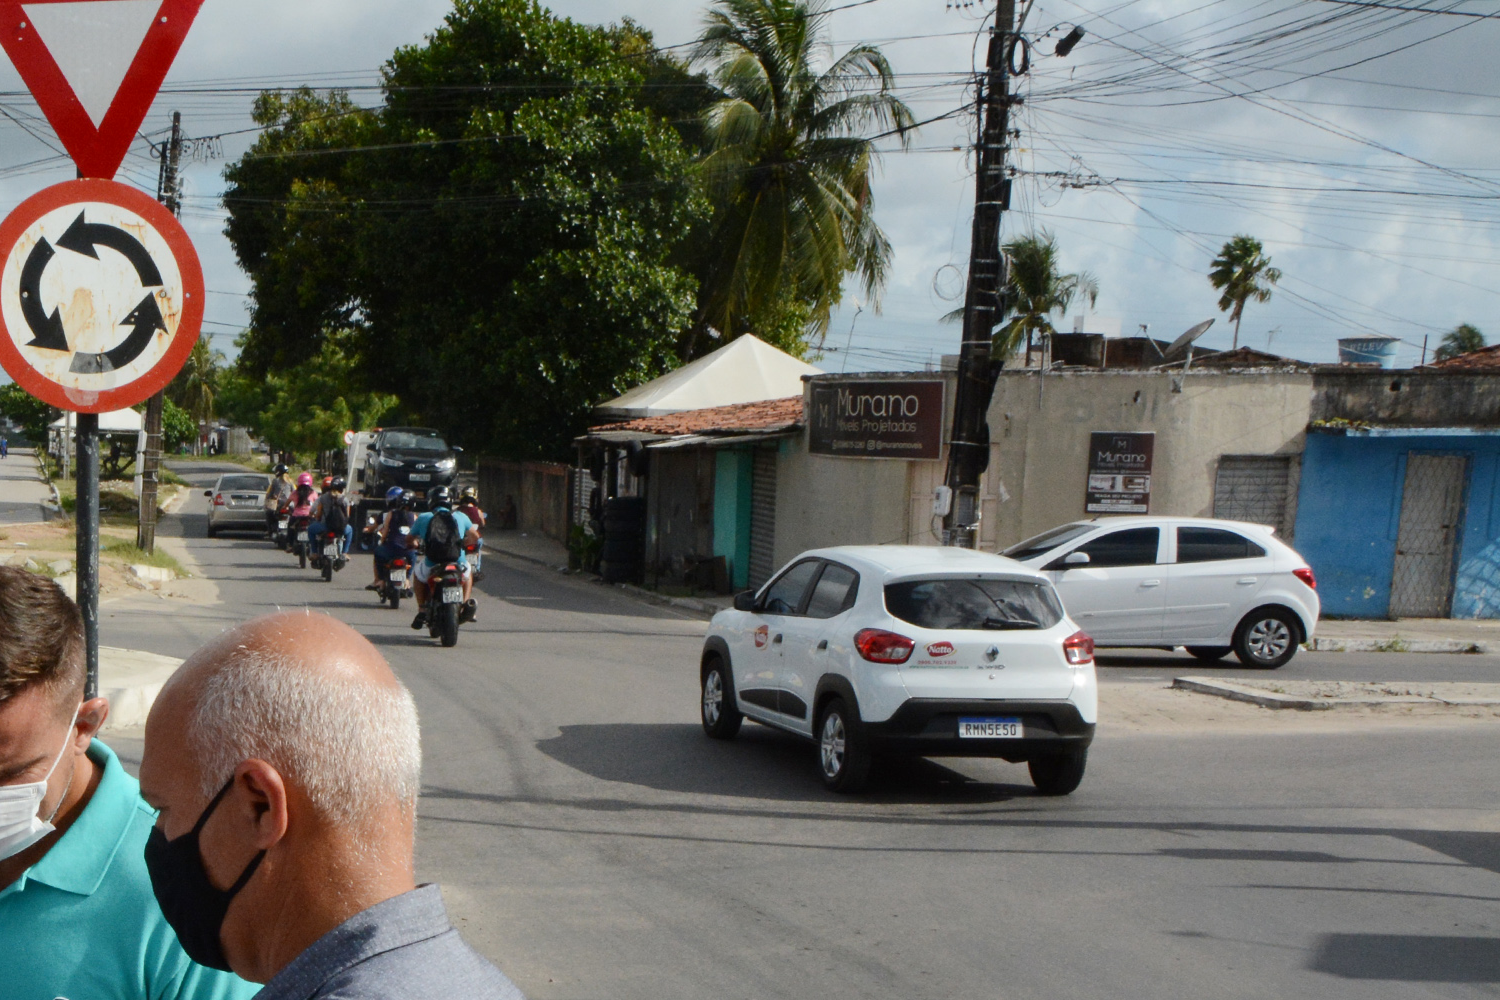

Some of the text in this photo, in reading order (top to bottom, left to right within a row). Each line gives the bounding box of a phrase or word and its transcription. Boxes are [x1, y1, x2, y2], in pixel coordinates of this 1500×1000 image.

[837, 387, 919, 417] Murano
[861, 419, 917, 435] Projetados
[1098, 451, 1147, 463] Murano
[928, 645, 953, 654] Natto
[965, 723, 1017, 737] RMN5E50
